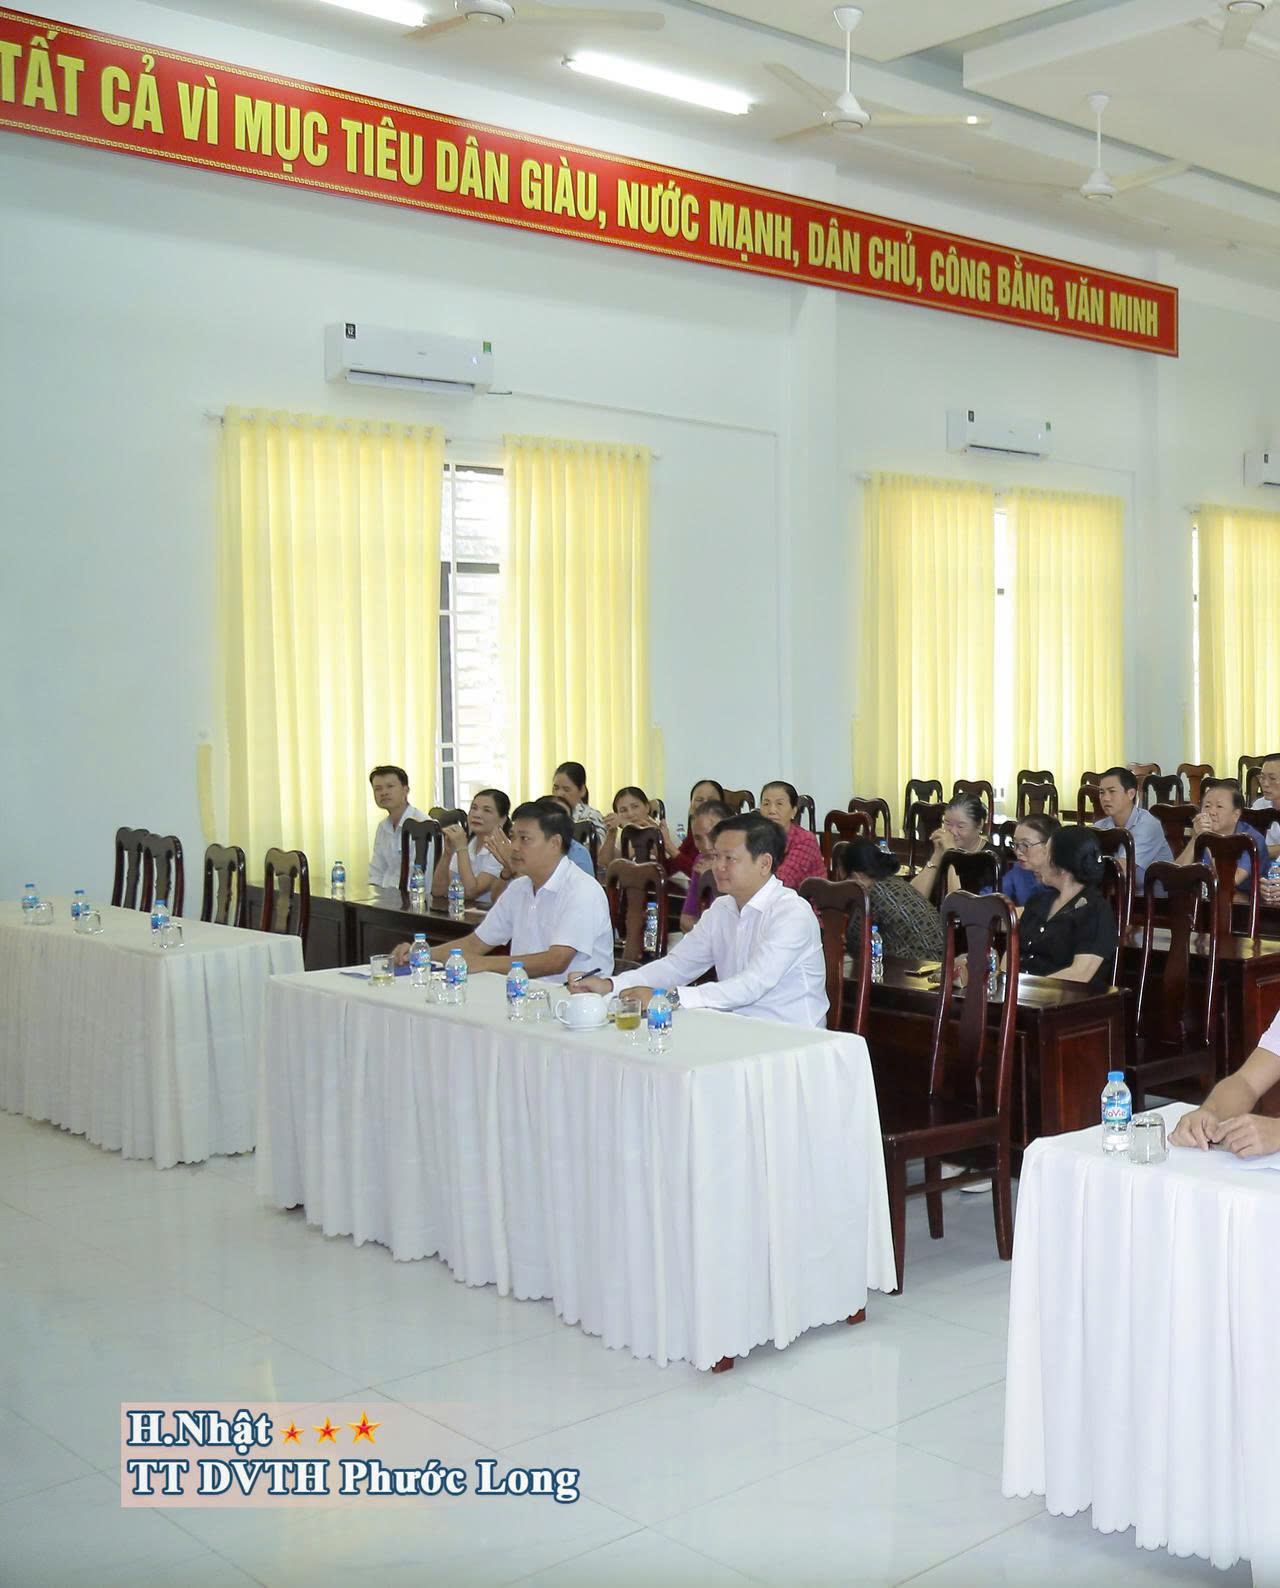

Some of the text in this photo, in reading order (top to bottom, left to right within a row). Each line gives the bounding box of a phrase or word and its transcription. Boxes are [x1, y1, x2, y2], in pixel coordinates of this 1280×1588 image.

[0, 30, 1159, 337] TẤT CẢ VÌ MỤC TIÊU DÂN GIÀU, NƯỚC MẠNH, DÂN CHỦ, CÔNG BẰNG, VĂN MINH
